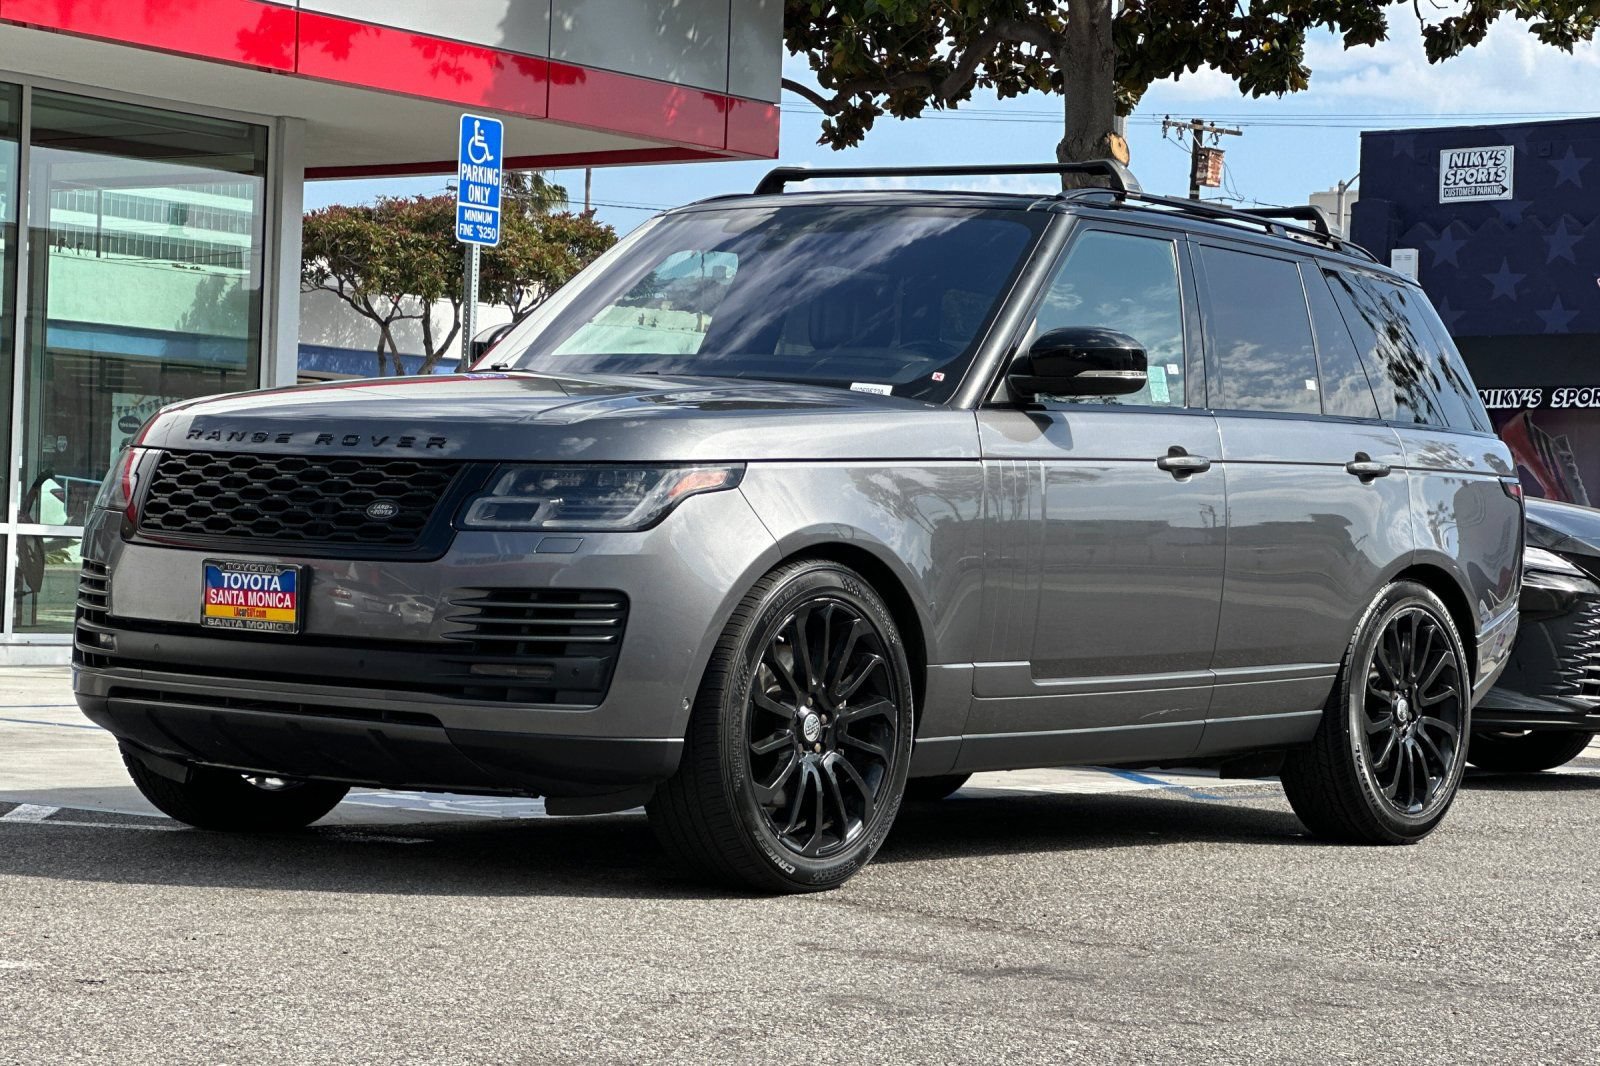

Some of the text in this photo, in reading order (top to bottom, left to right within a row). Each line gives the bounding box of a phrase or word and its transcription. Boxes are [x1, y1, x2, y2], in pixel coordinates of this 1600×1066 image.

[1449, 150, 1506, 169] NIKY'S
[461, 163, 499, 186] PARKING
[1443, 166, 1507, 186] SPORTS
[468, 184, 491, 204] ONLY
[1444, 185, 1503, 197] CUSTOMER PARKING
[464, 209, 493, 224] MINIMUM
[459, 223, 497, 240] FINE $250
[1478, 388, 1543, 409] NIKY'S
[186, 429, 448, 449] RANGE ROVER
[225, 562, 275, 573] TOYOTA
[221, 573, 281, 591] TOYOTA
[210, 589, 292, 608] SANTA MONICA
[207, 618, 244, 628] SANTA
